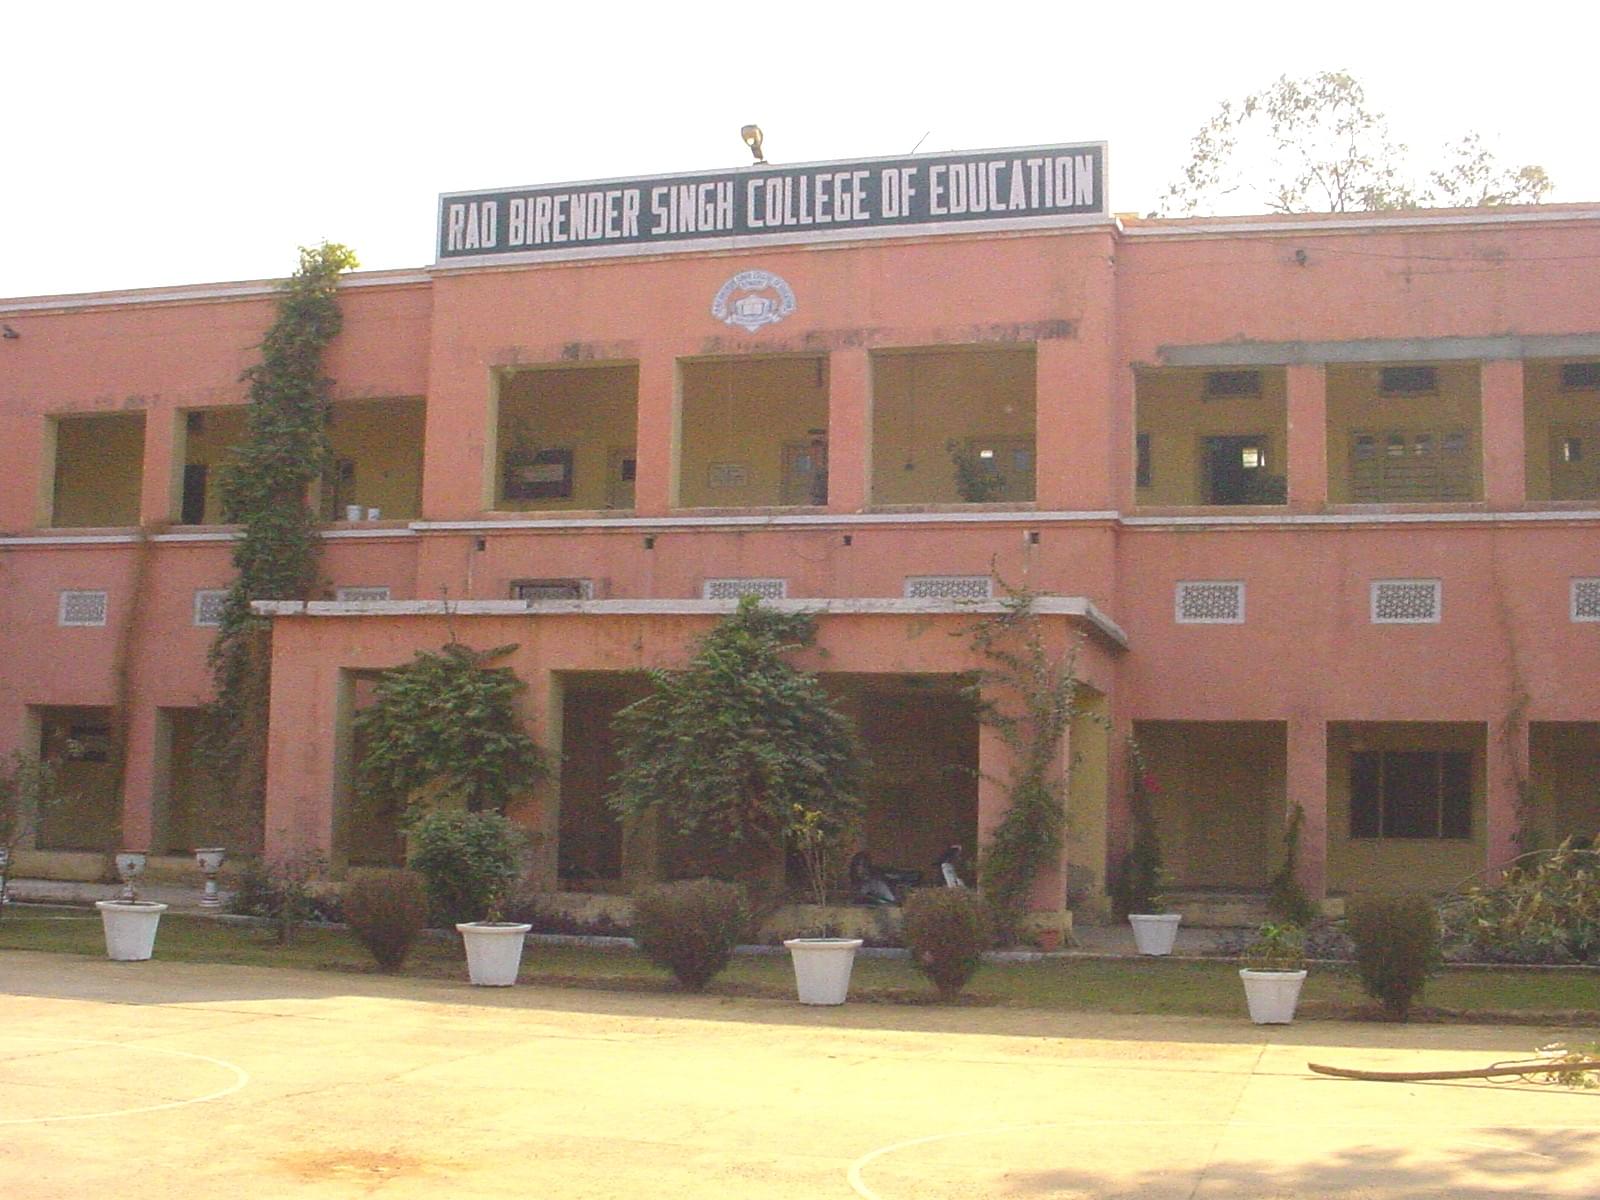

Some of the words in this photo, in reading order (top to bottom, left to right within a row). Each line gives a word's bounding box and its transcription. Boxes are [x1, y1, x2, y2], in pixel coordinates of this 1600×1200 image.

[448, 201, 497, 251] RAO
[508, 188, 640, 246] BIRENDER
[651, 181, 734, 235] SINGH
[747, 170, 871, 228] COLLEGE
[881, 167, 918, 218] OF
[929, 154, 1094, 215] EDUCATION
